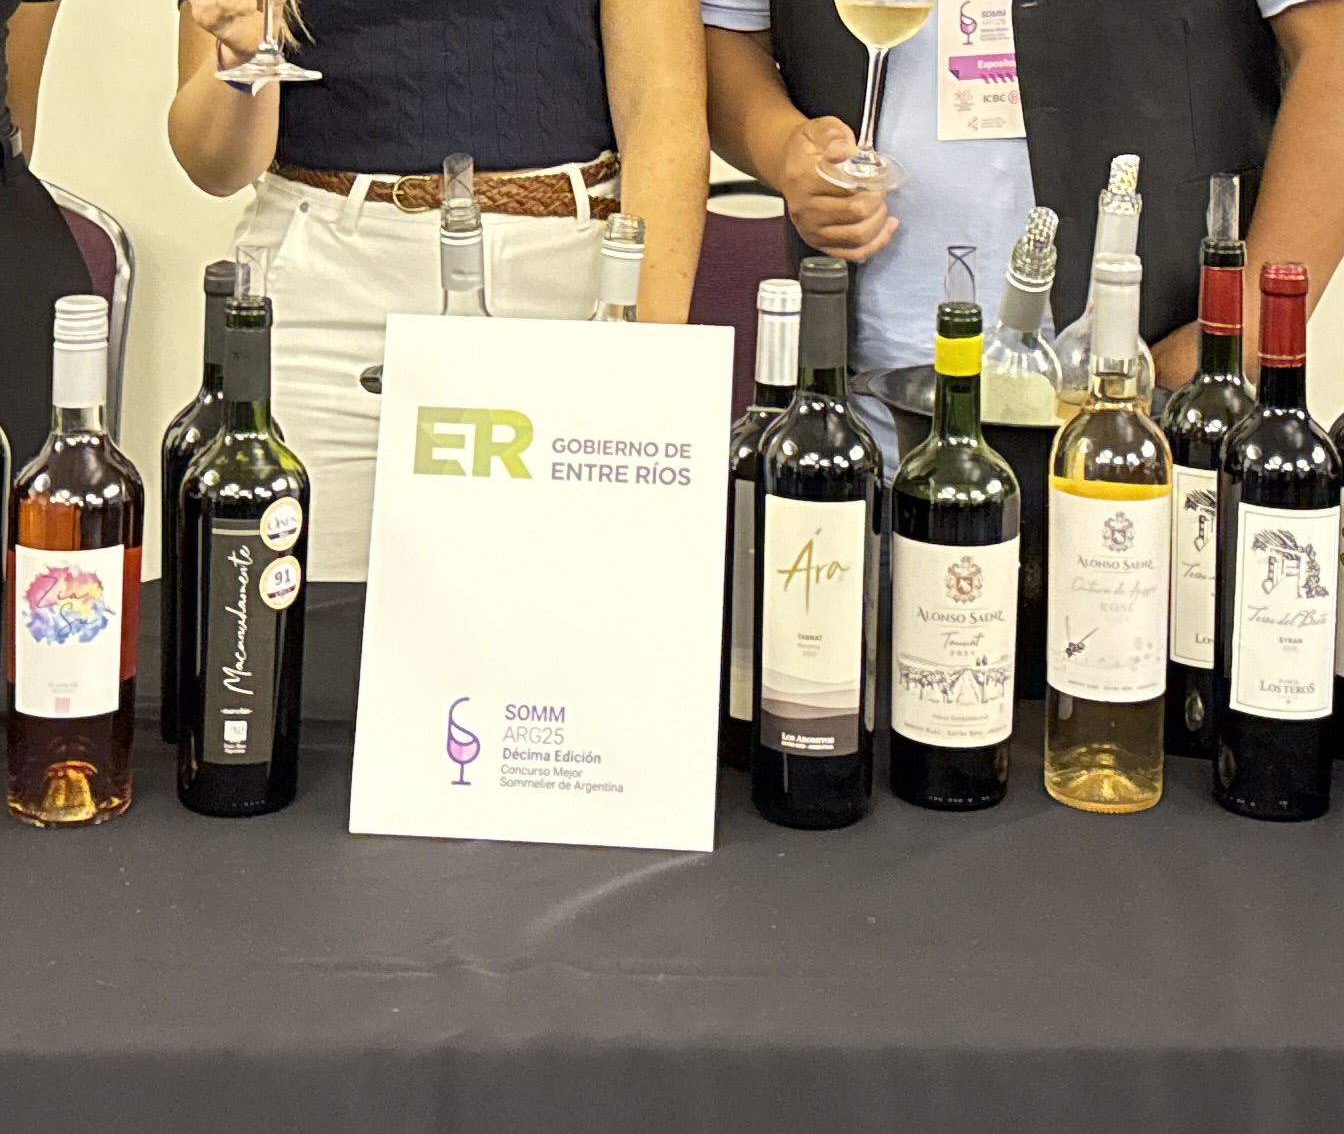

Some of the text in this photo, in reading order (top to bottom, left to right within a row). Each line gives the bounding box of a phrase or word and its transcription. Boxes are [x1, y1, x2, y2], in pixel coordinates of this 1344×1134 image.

[978, 60, 1016, 69] Exposito
[983, 94, 1006, 103] ICBC
[413, 406, 534, 479] ER
[552, 437, 692, 458] GOBIERNO DE
[551, 462, 691, 486] ENTRE RÍOS
[274, 568, 291, 586] 91
[505, 704, 565, 722] SOMM
[502, 726, 564, 745] ARG25
[502, 747, 601, 764] Décima Edición
[501, 764, 583, 780] Concurso Mejor
[500, 777, 623, 794] Sommelier de Argentina
